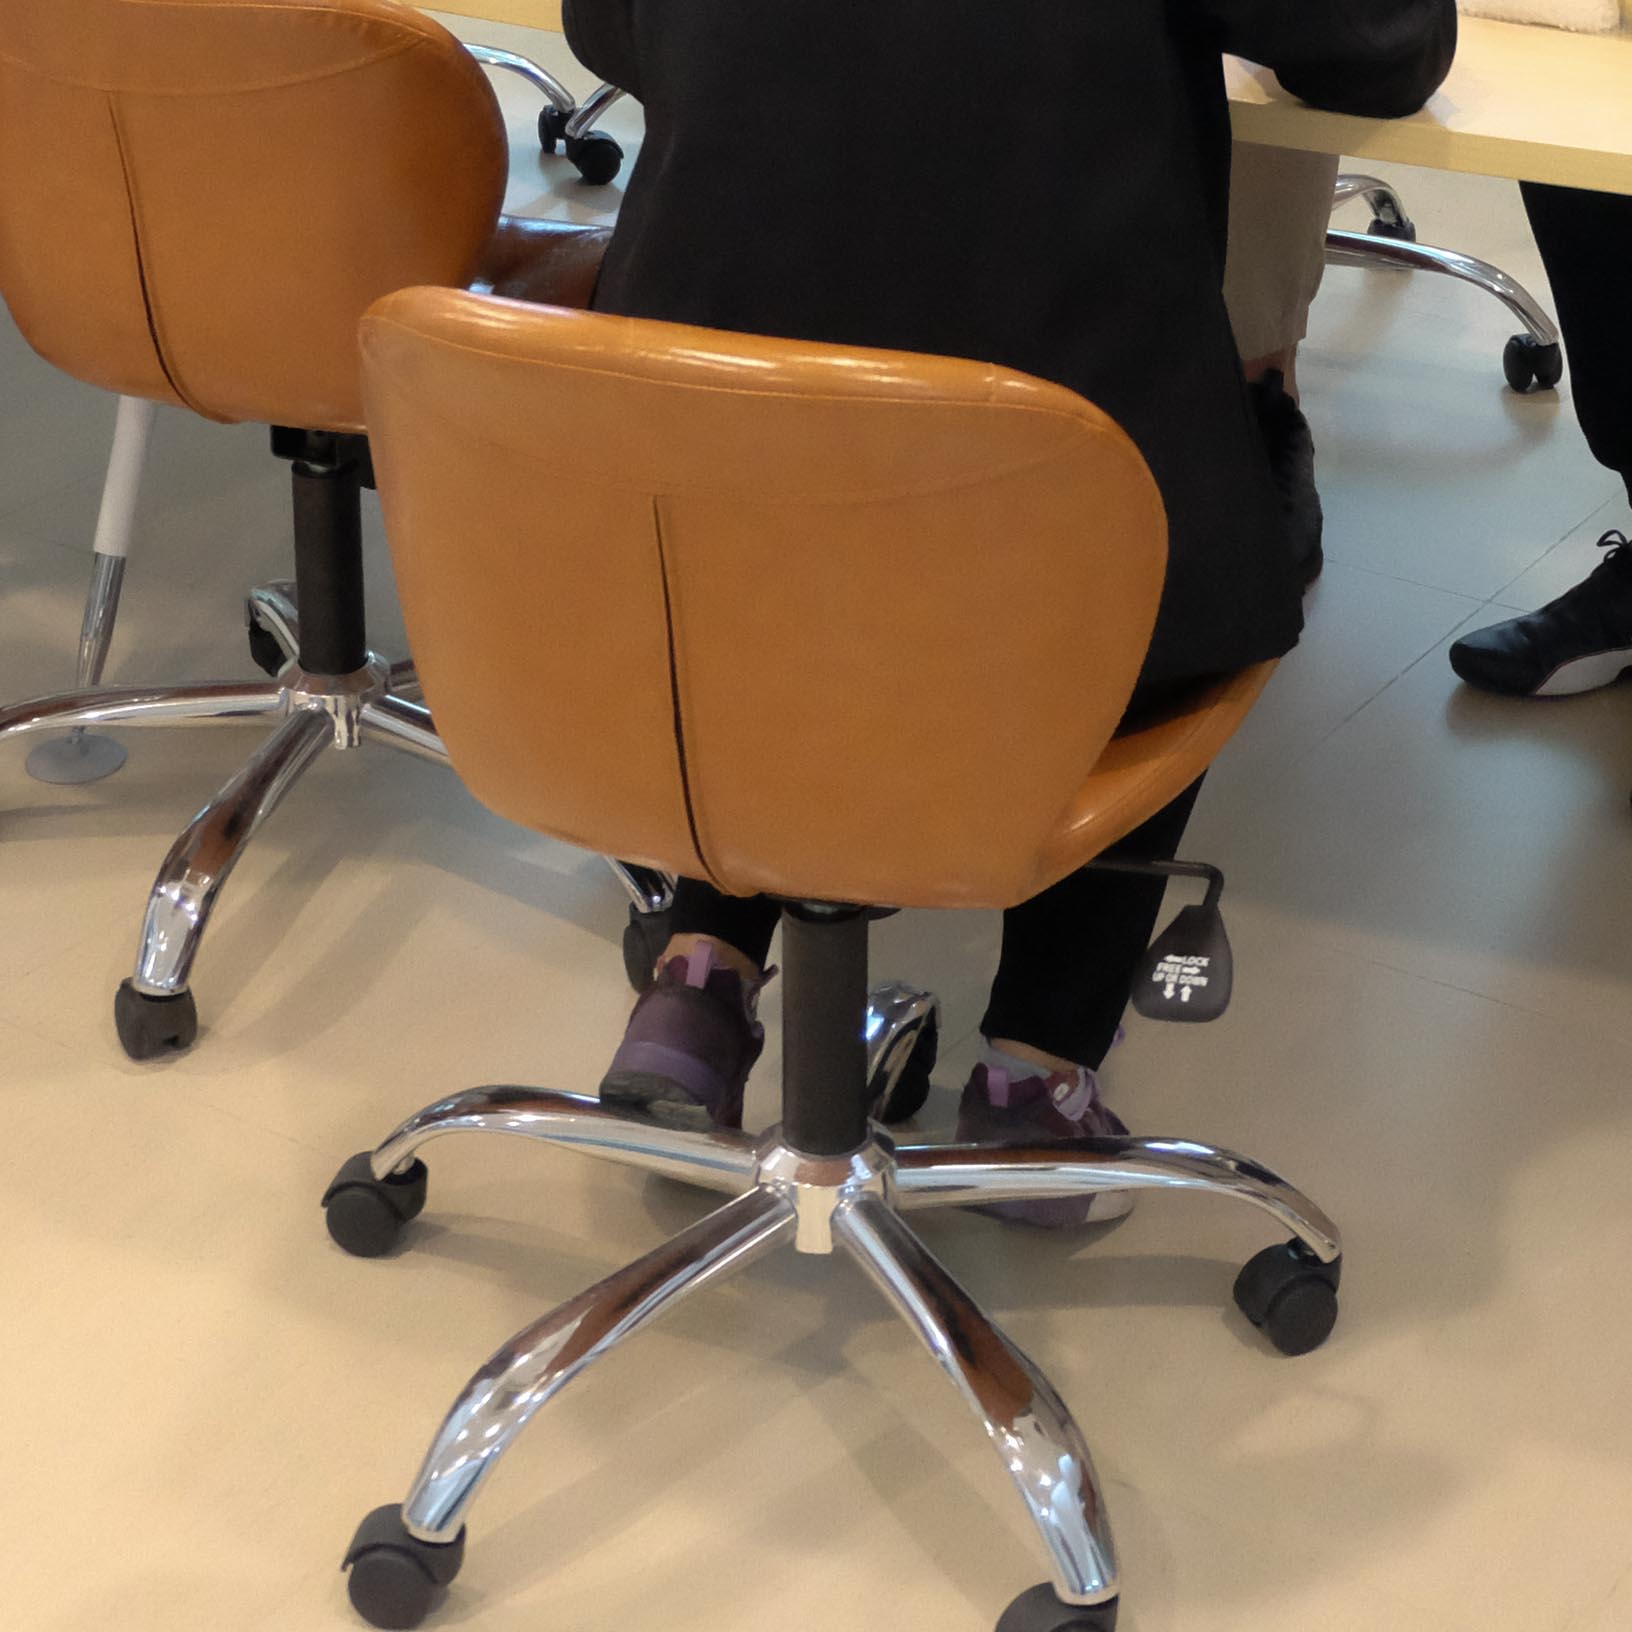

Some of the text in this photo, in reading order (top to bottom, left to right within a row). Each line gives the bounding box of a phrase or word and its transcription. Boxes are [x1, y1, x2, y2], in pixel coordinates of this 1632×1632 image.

[1156, 962, 1181, 973] FREE
[1181, 955, 1210, 968] LOCK
[1151, 971, 1166, 982] UP
[1179, 974, 1209, 987] DOWN
